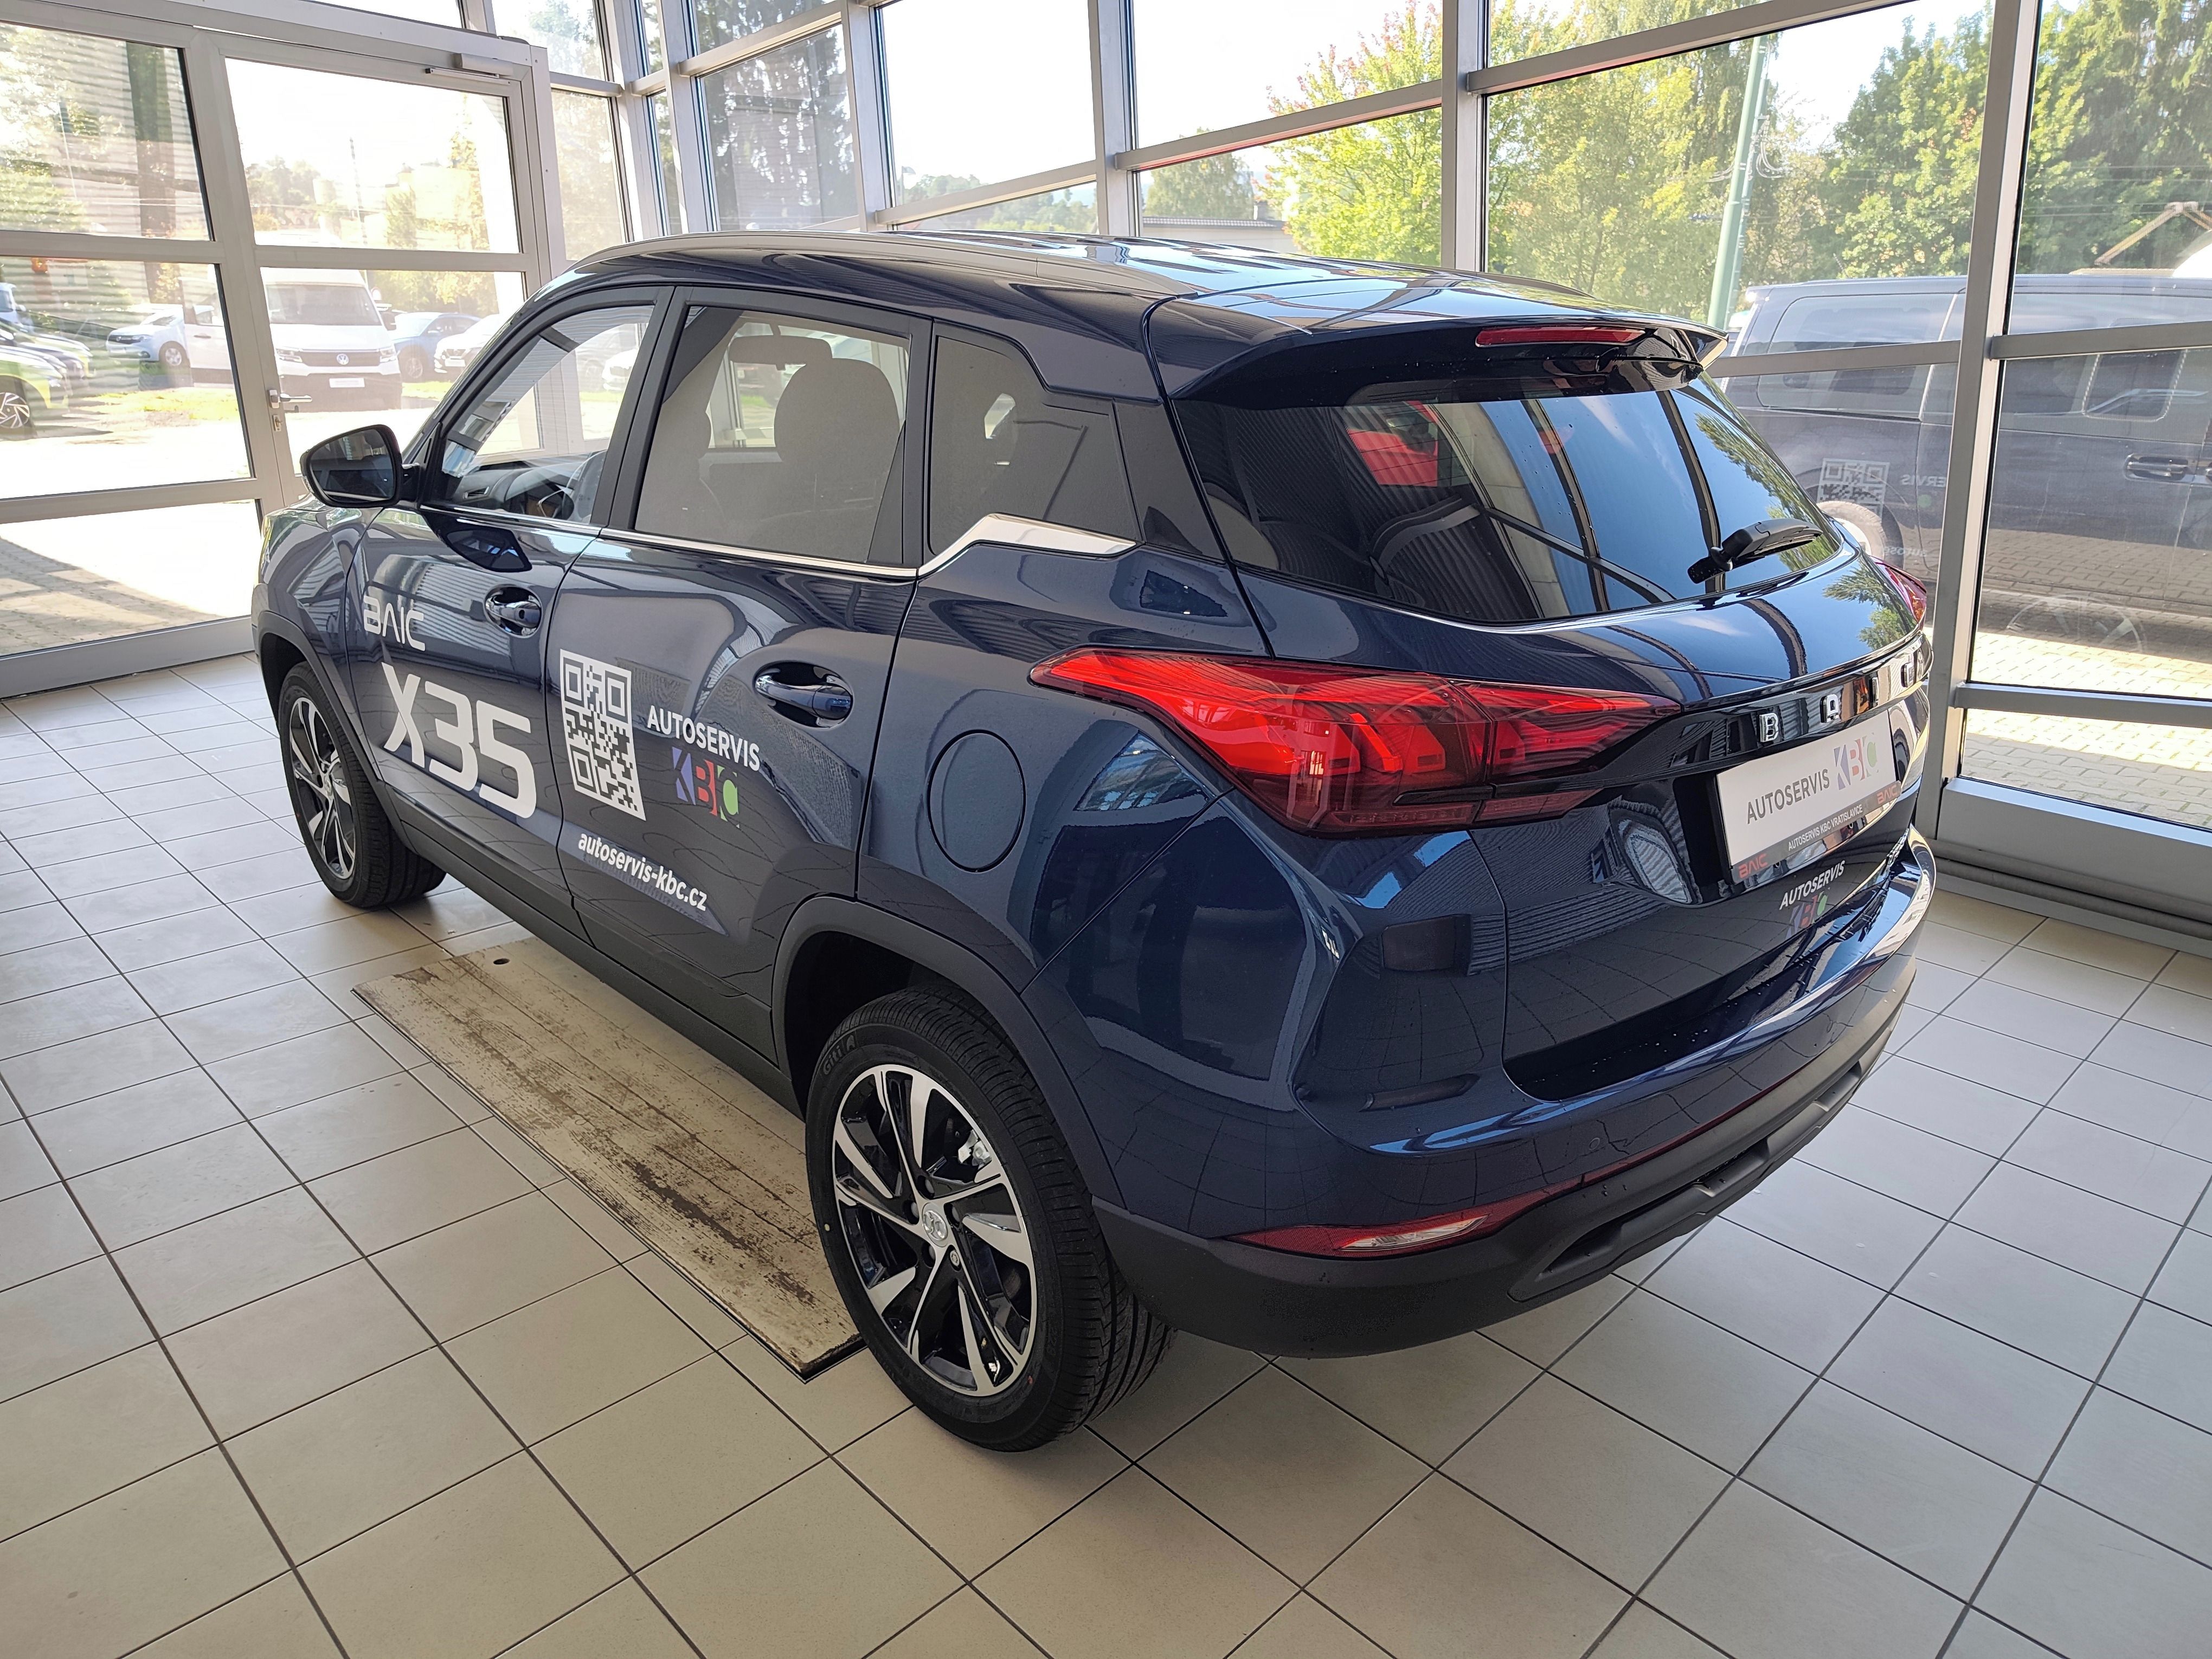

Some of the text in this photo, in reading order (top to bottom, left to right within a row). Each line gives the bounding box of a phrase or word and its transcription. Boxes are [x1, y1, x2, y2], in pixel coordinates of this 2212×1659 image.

[363, 595, 425, 651] BAIC
[381, 661, 537, 819] X35
[647, 705, 760, 771] AUTOSERVIS
[1747, 768, 1830, 825] AUTOSERVIS
[1877, 785, 1898, 805] BAIC
[1788, 804, 1863, 851] AUTOSERVIS KBC VRATISLAVICE
[578, 833, 708, 911] autoservis-kbc.cz
[1738, 853, 1769, 879] BAIC
[1779, 860, 1846, 910] AUTOSERVIS
[823, 1045, 843, 1075] Giti
